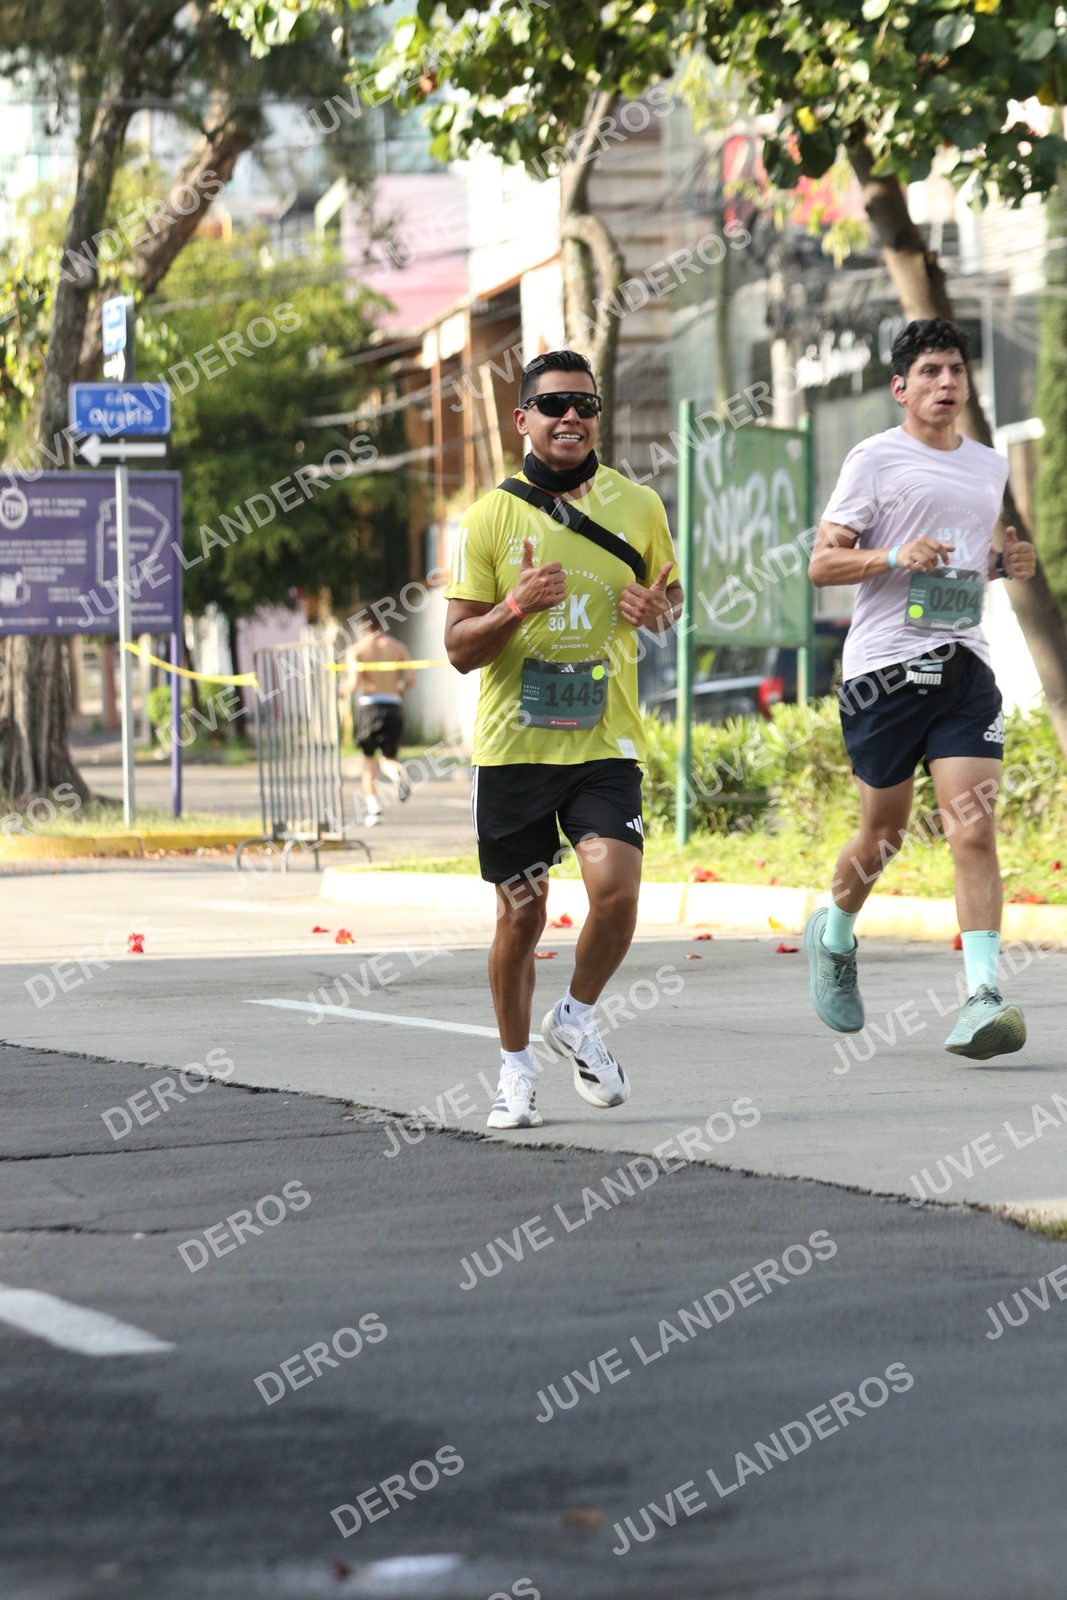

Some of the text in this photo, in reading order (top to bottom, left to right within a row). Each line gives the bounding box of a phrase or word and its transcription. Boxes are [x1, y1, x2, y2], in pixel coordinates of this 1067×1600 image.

[570, 594, 592, 630] K
[929, 586, 980, 614] 0204
[548, 617, 566, 631] 30
[906, 670, 942, 685] PUMA
[545, 681, 605, 707] 1445
